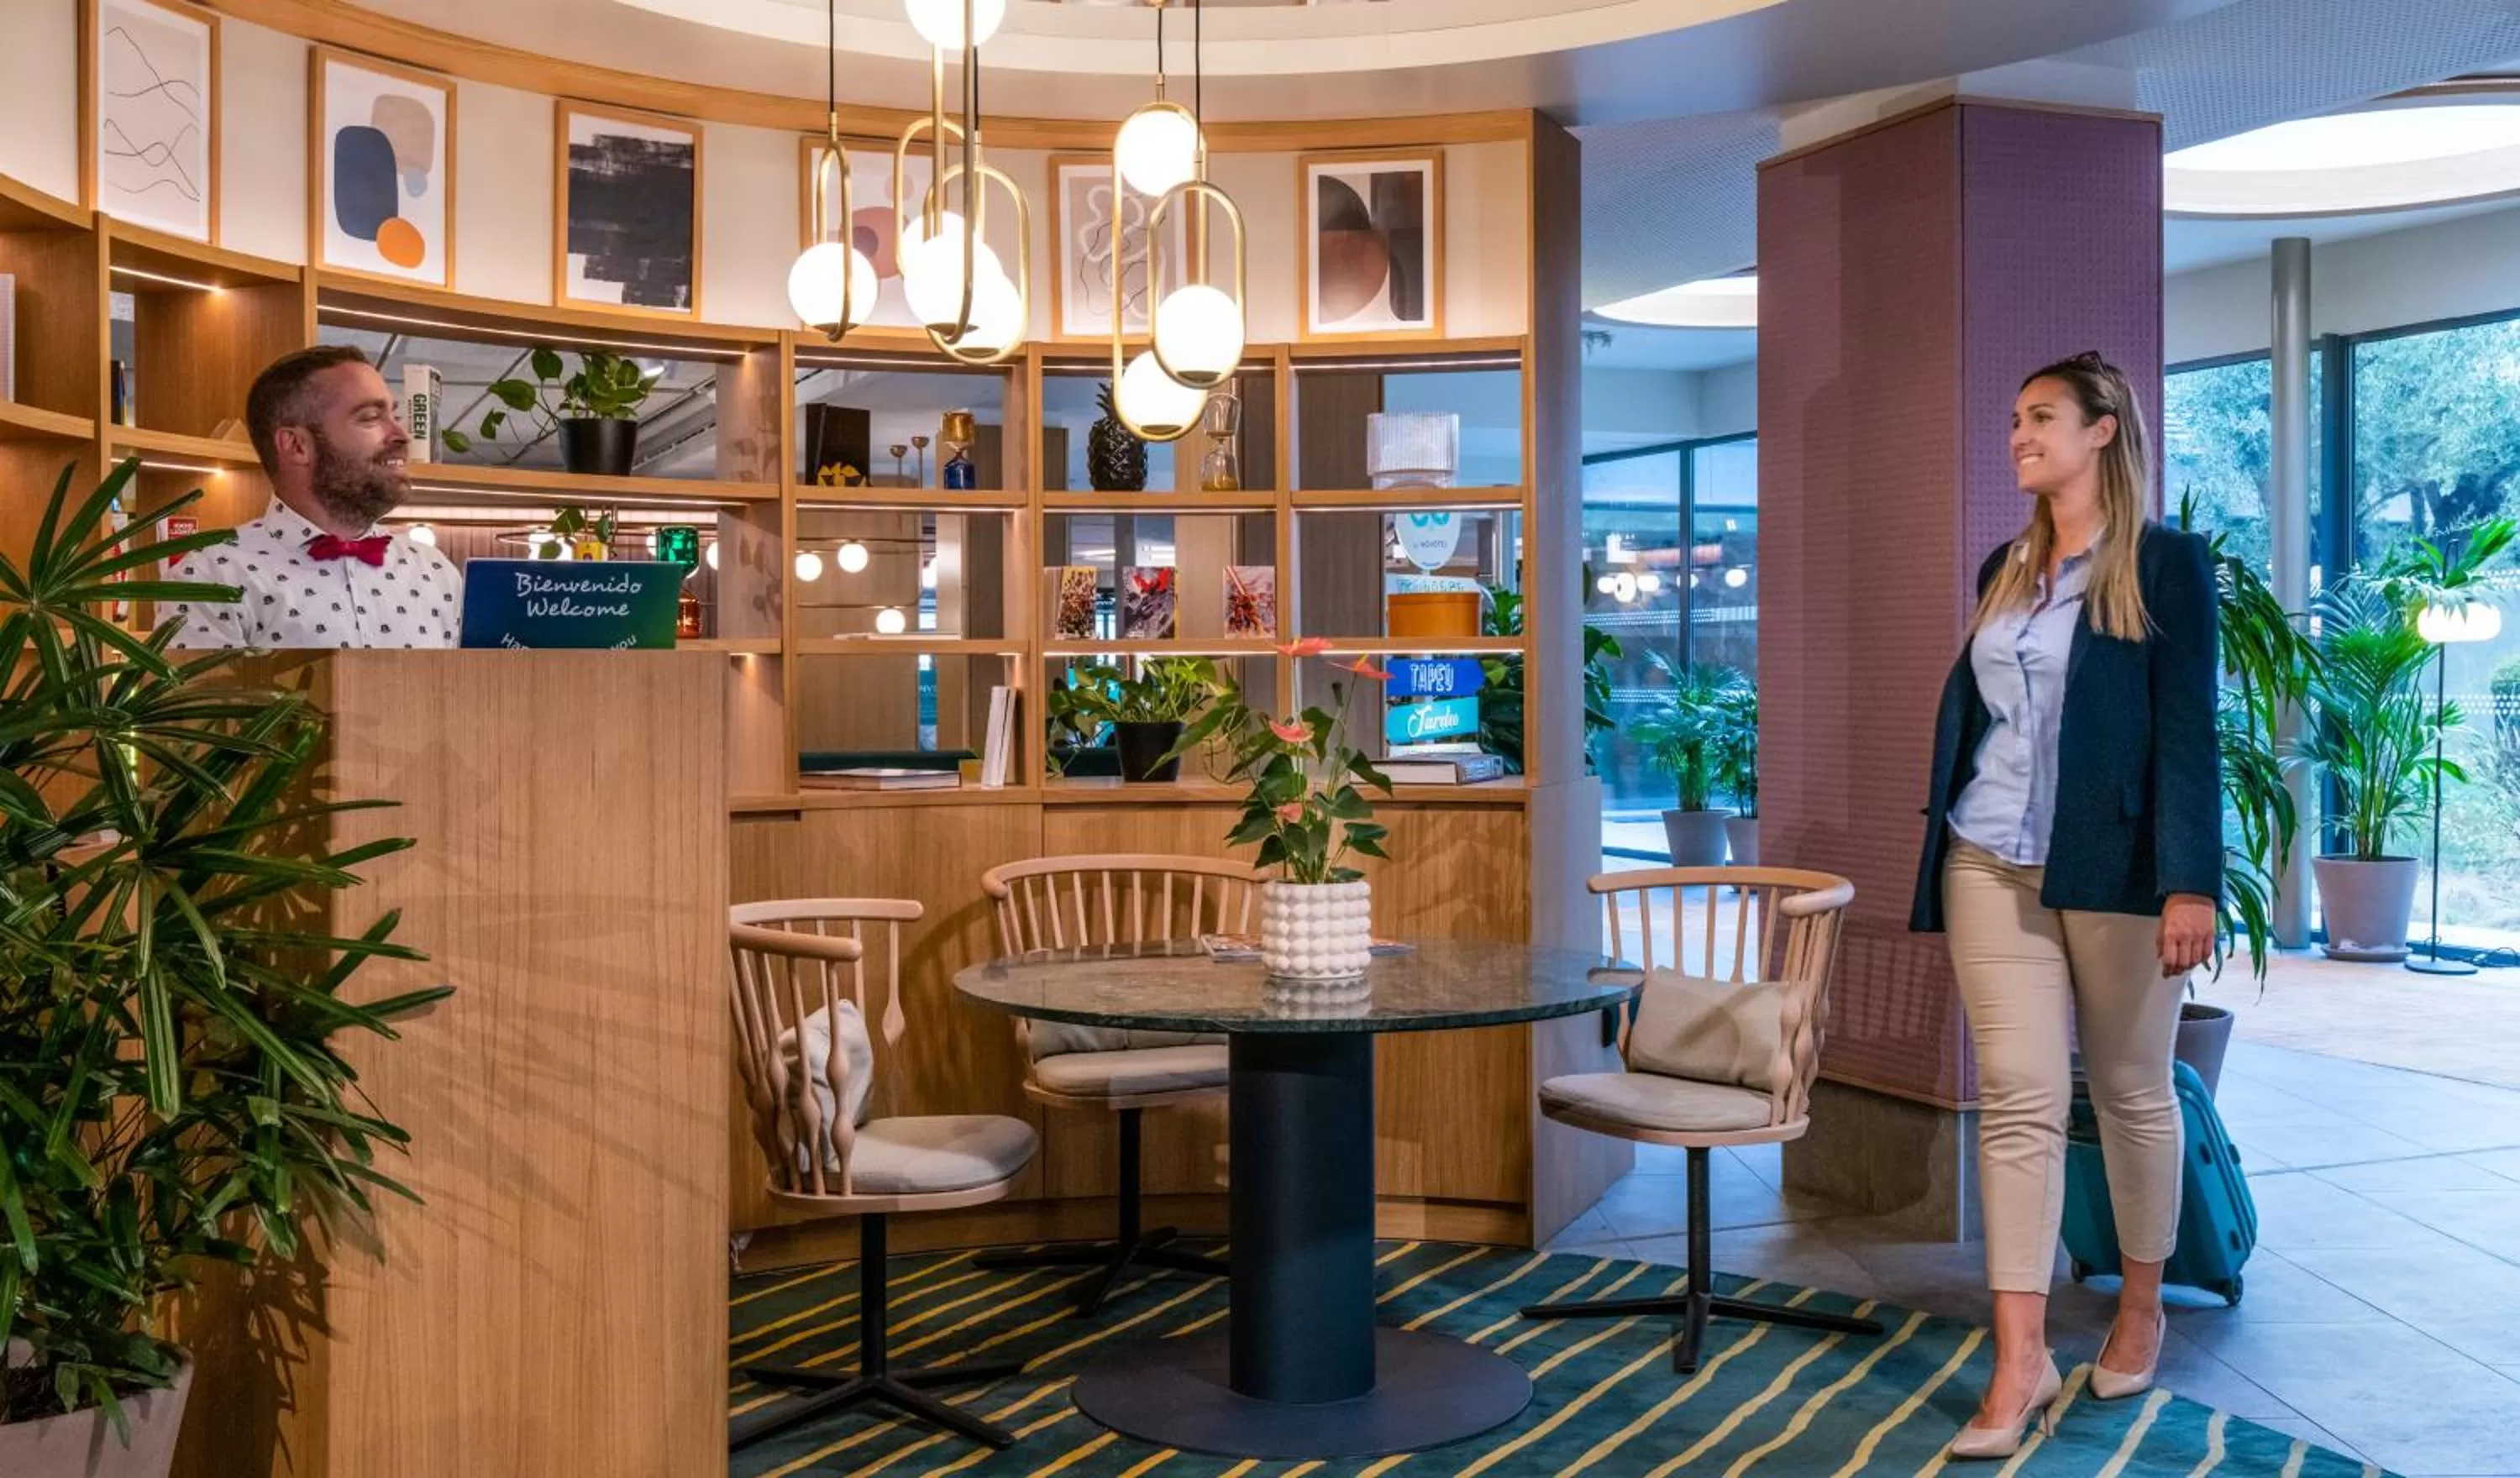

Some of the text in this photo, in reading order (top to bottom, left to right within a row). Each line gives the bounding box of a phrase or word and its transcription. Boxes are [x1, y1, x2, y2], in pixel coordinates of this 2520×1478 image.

[412, 393, 428, 439] GREEN
[514, 572, 643, 597] Bienvenido
[527, 597, 631, 617] Welcome
